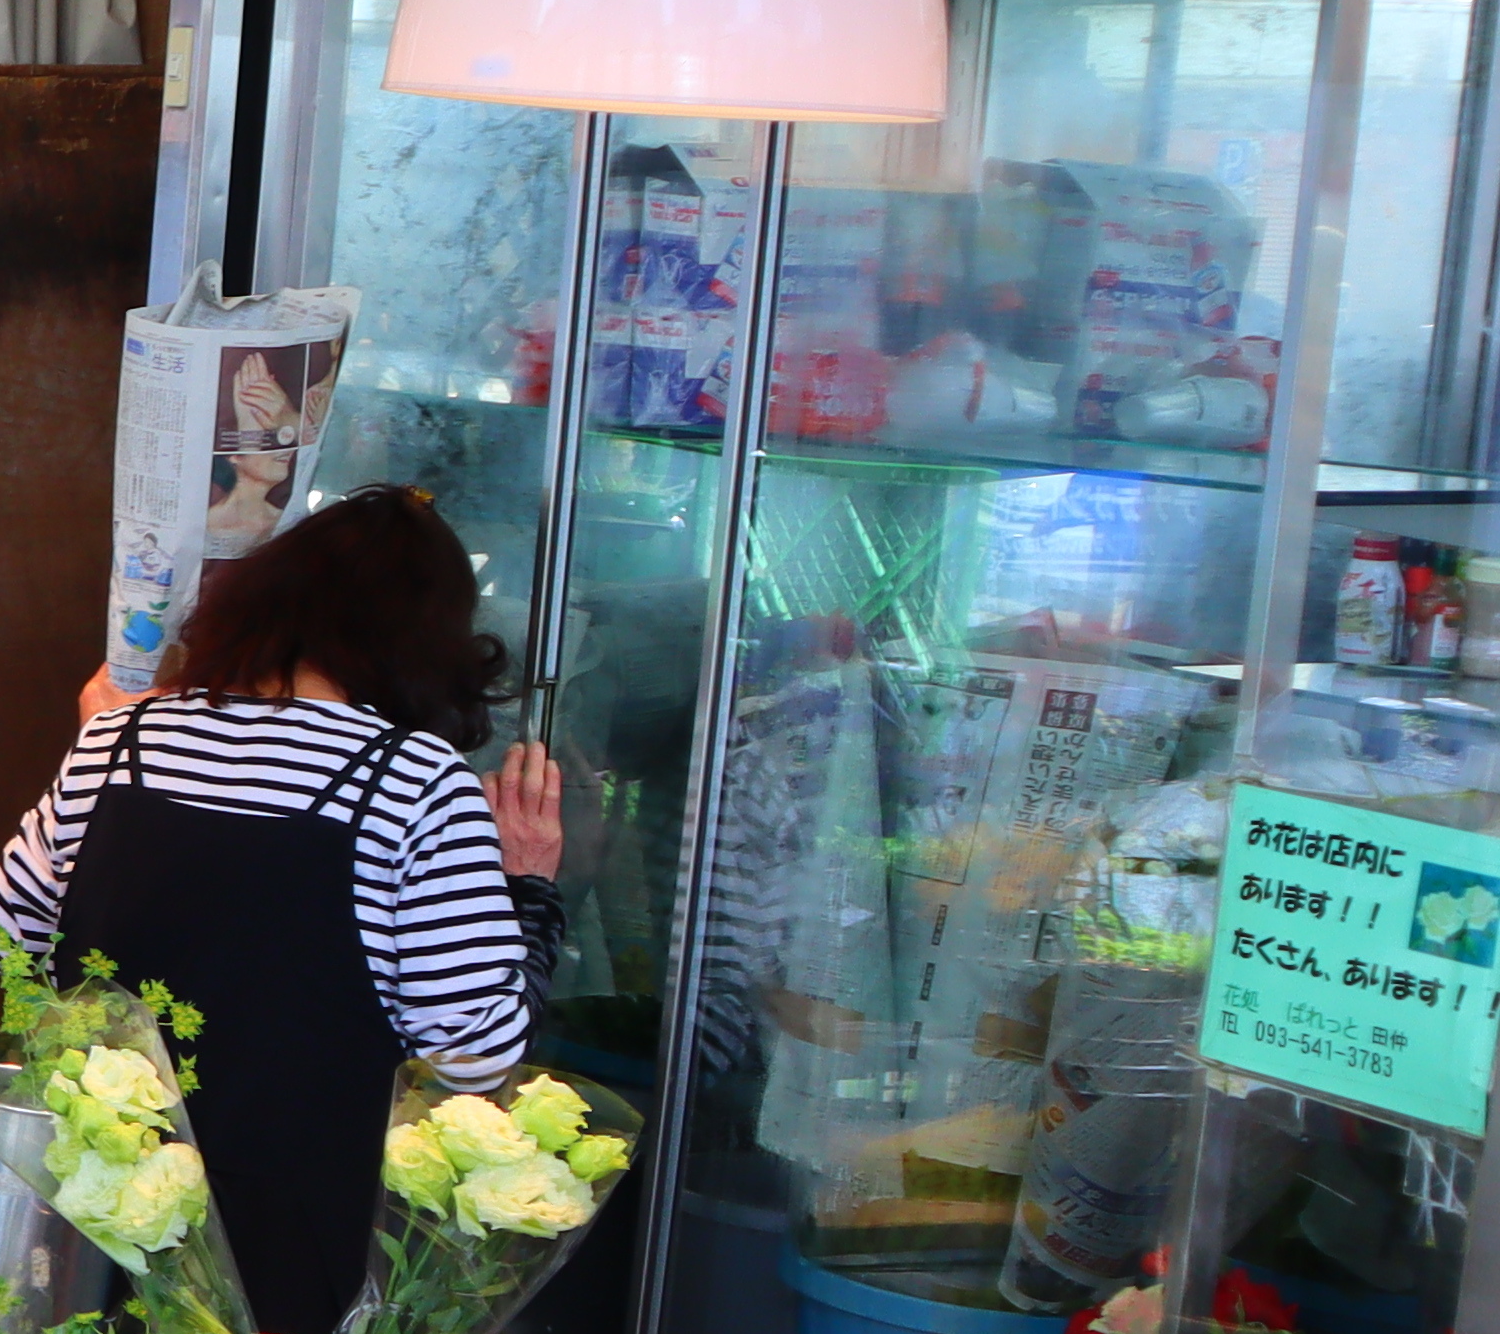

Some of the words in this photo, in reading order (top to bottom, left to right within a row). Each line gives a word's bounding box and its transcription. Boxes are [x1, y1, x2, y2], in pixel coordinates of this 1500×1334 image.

[153, 354, 186, 374] 生活
[1248, 819, 1407, 877] お花は店内に
[1223, 984, 1261, 1014] 花処
[1371, 1026, 1409, 1053] 田仲
[1255, 1021, 1394, 1078] 093-541-3783
